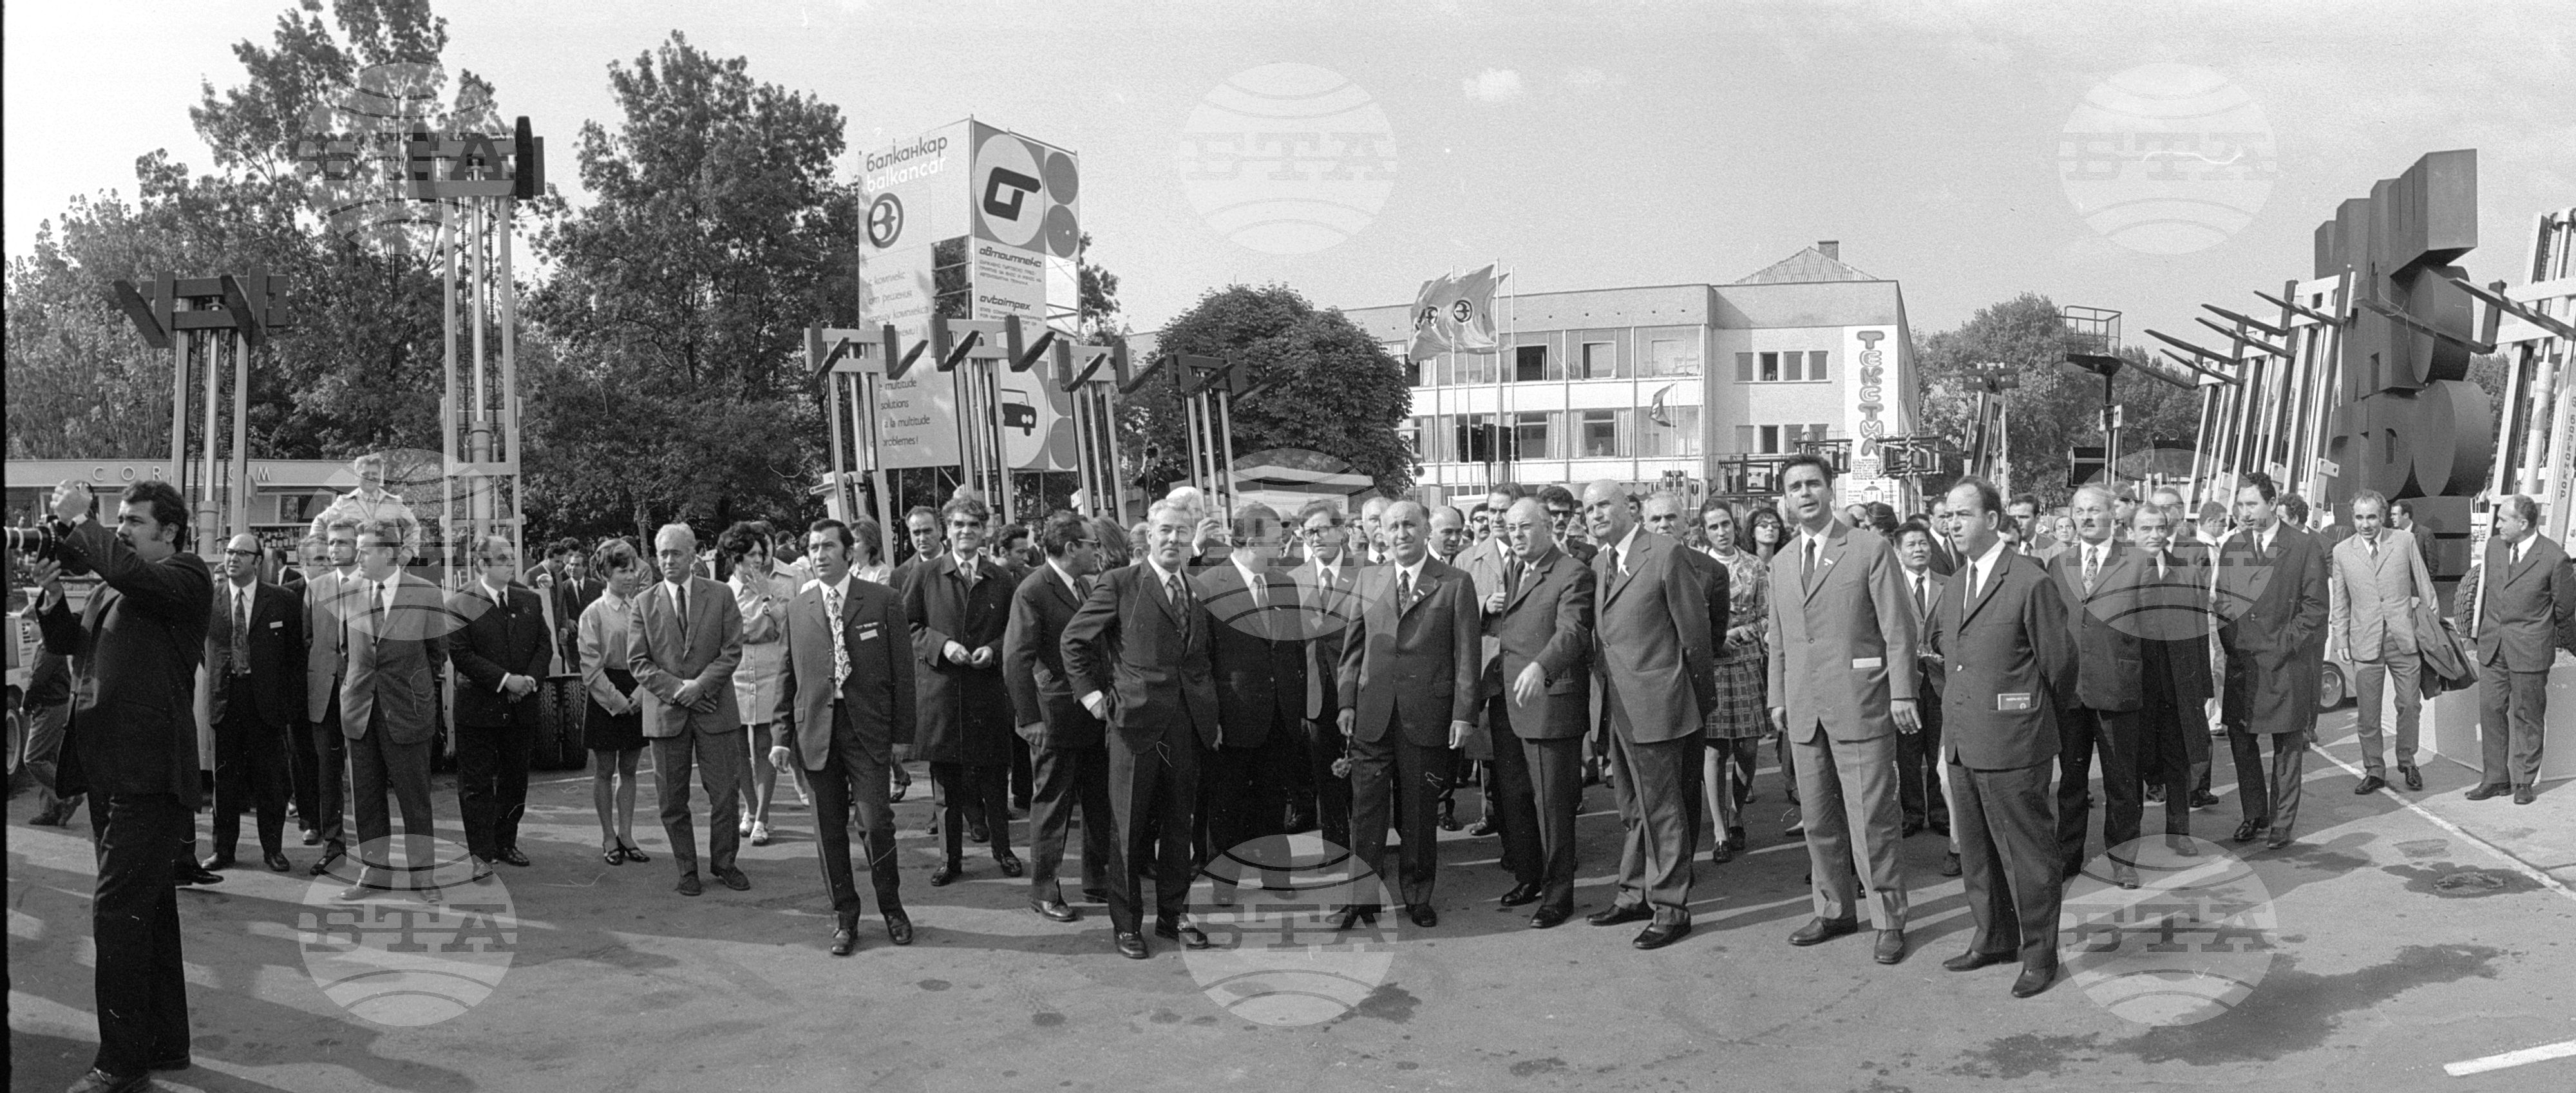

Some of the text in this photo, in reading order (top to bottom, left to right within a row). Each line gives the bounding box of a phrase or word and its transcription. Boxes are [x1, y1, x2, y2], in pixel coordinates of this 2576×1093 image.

[866, 137, 947, 172] балканкар
[867, 156, 947, 192] balkancar
[980, 295, 1032, 311] avtoimpex
[886, 377, 916, 390] multitude
[880, 399, 909, 410] solutions
[898, 415, 930, 427] multitude
[92, 466, 271, 481] CORM
